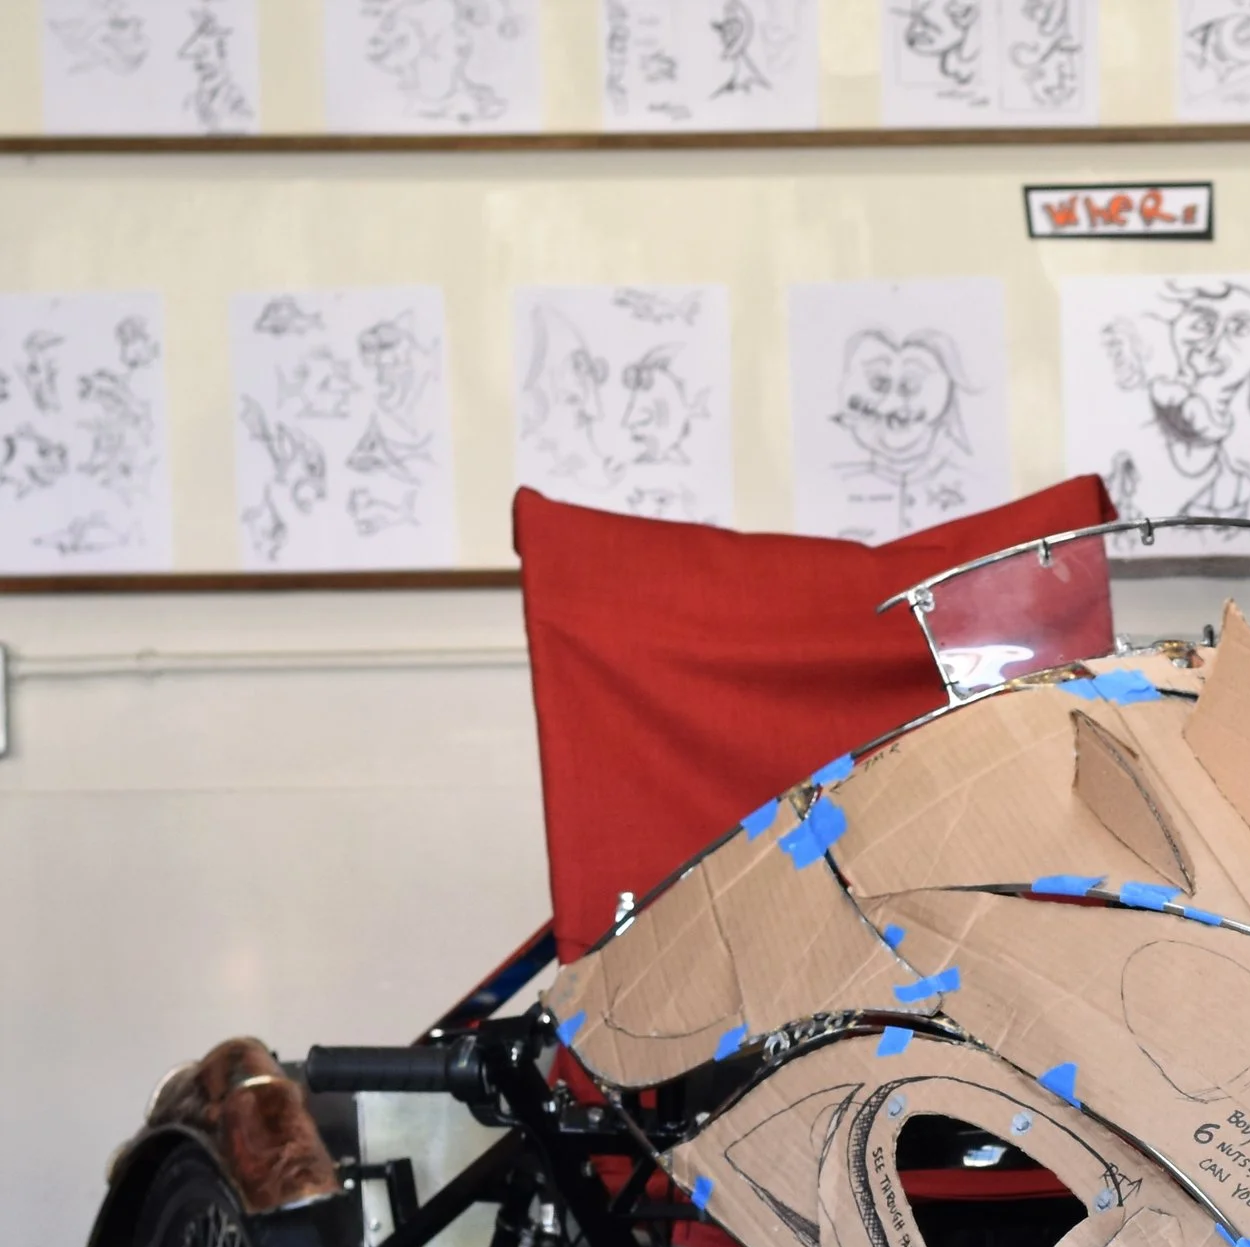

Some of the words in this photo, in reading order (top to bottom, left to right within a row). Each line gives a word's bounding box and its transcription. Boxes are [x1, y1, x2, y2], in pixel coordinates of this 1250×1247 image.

[1193, 1123, 1220, 1144] 6
[1199, 1158, 1232, 1184] CAN
[872, 1146, 886, 1175] SEE
[879, 1174, 907, 1232] THROUGH
